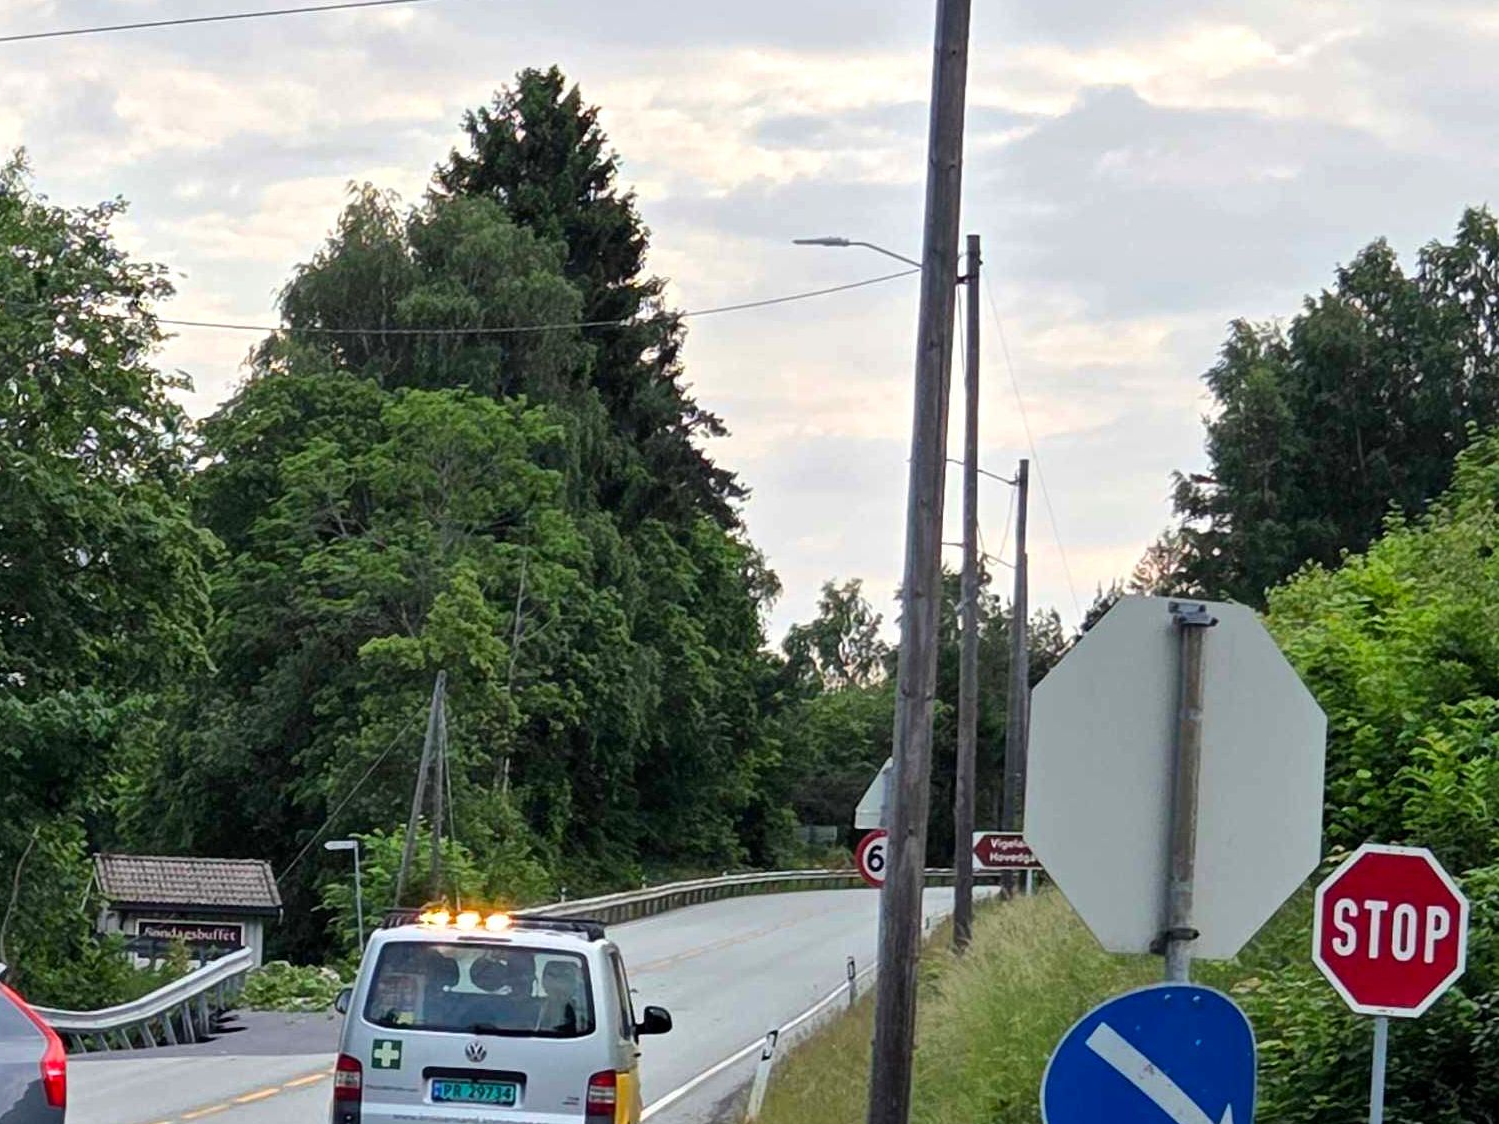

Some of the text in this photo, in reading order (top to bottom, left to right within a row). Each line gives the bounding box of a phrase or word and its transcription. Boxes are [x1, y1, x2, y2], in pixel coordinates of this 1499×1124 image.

[990, 838, 1029, 850] Vigela
[867, 845, 885, 872] 6
[1332, 898, 1450, 964] STOP
[443, 1083, 512, 1100] PR 29734
